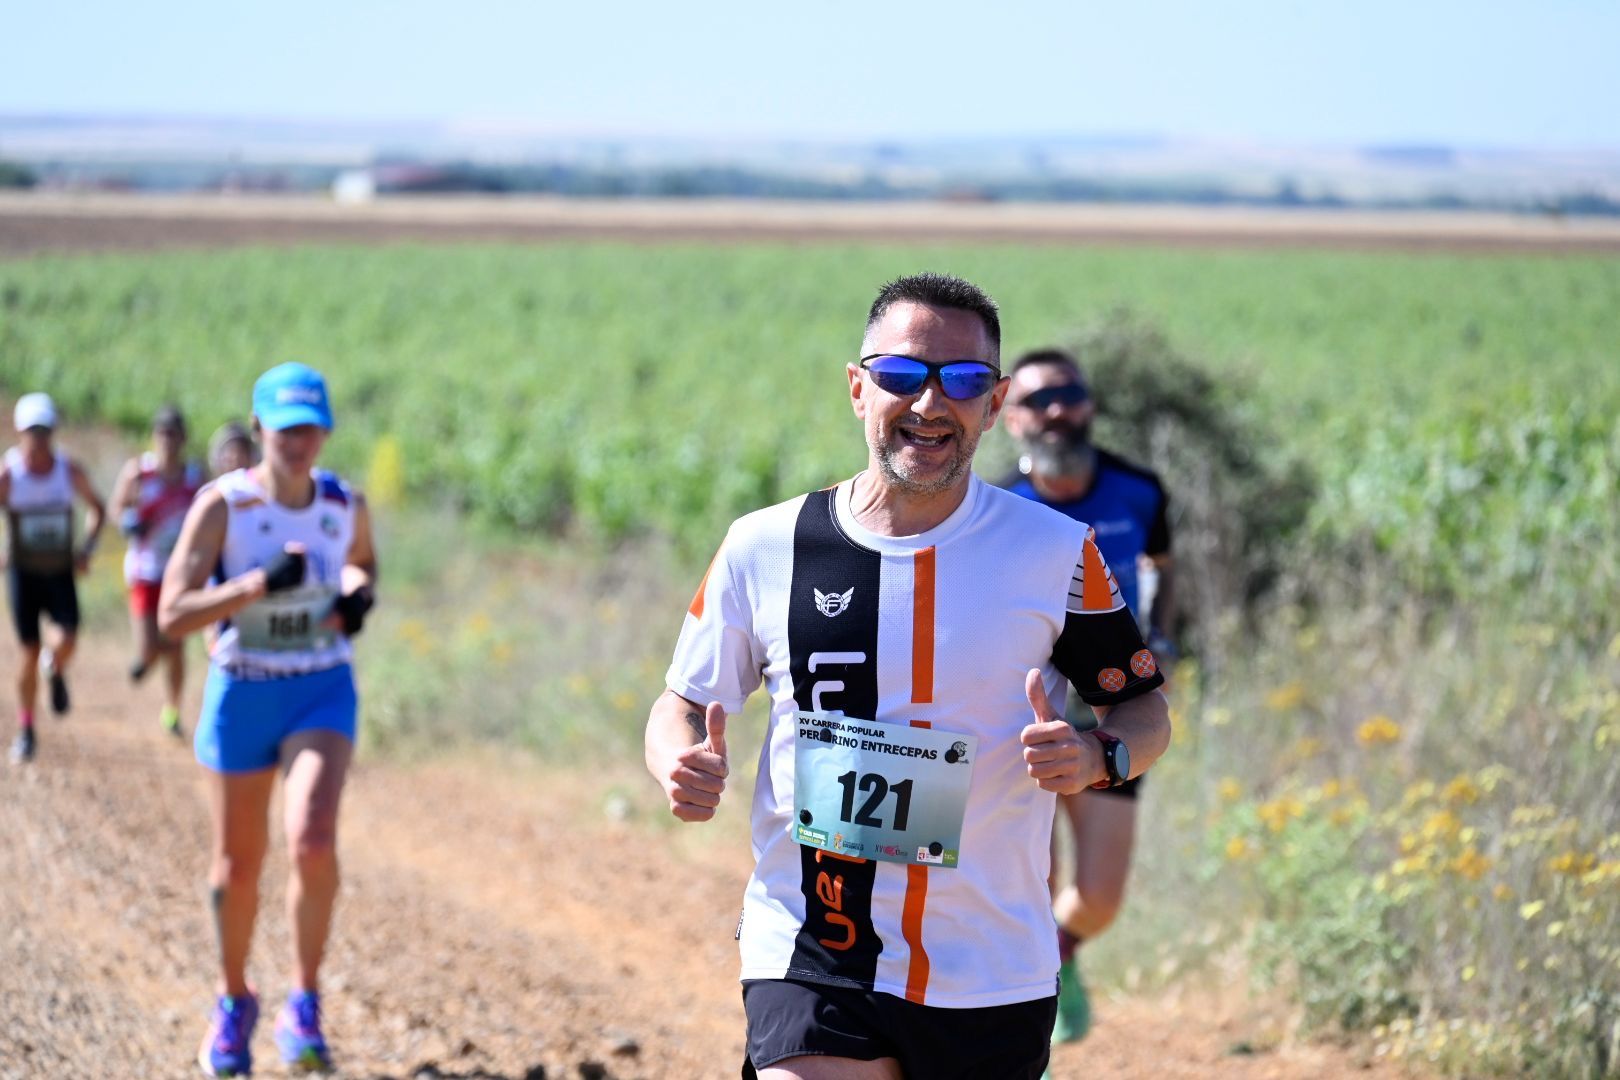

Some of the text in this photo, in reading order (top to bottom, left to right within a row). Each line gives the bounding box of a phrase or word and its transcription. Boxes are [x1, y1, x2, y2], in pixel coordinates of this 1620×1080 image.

[799, 717, 886, 739] XV CARRERA POPULAR
[799, 728, 938, 760] PERRINO ENTRECEPAS
[837, 770, 914, 832] 121
